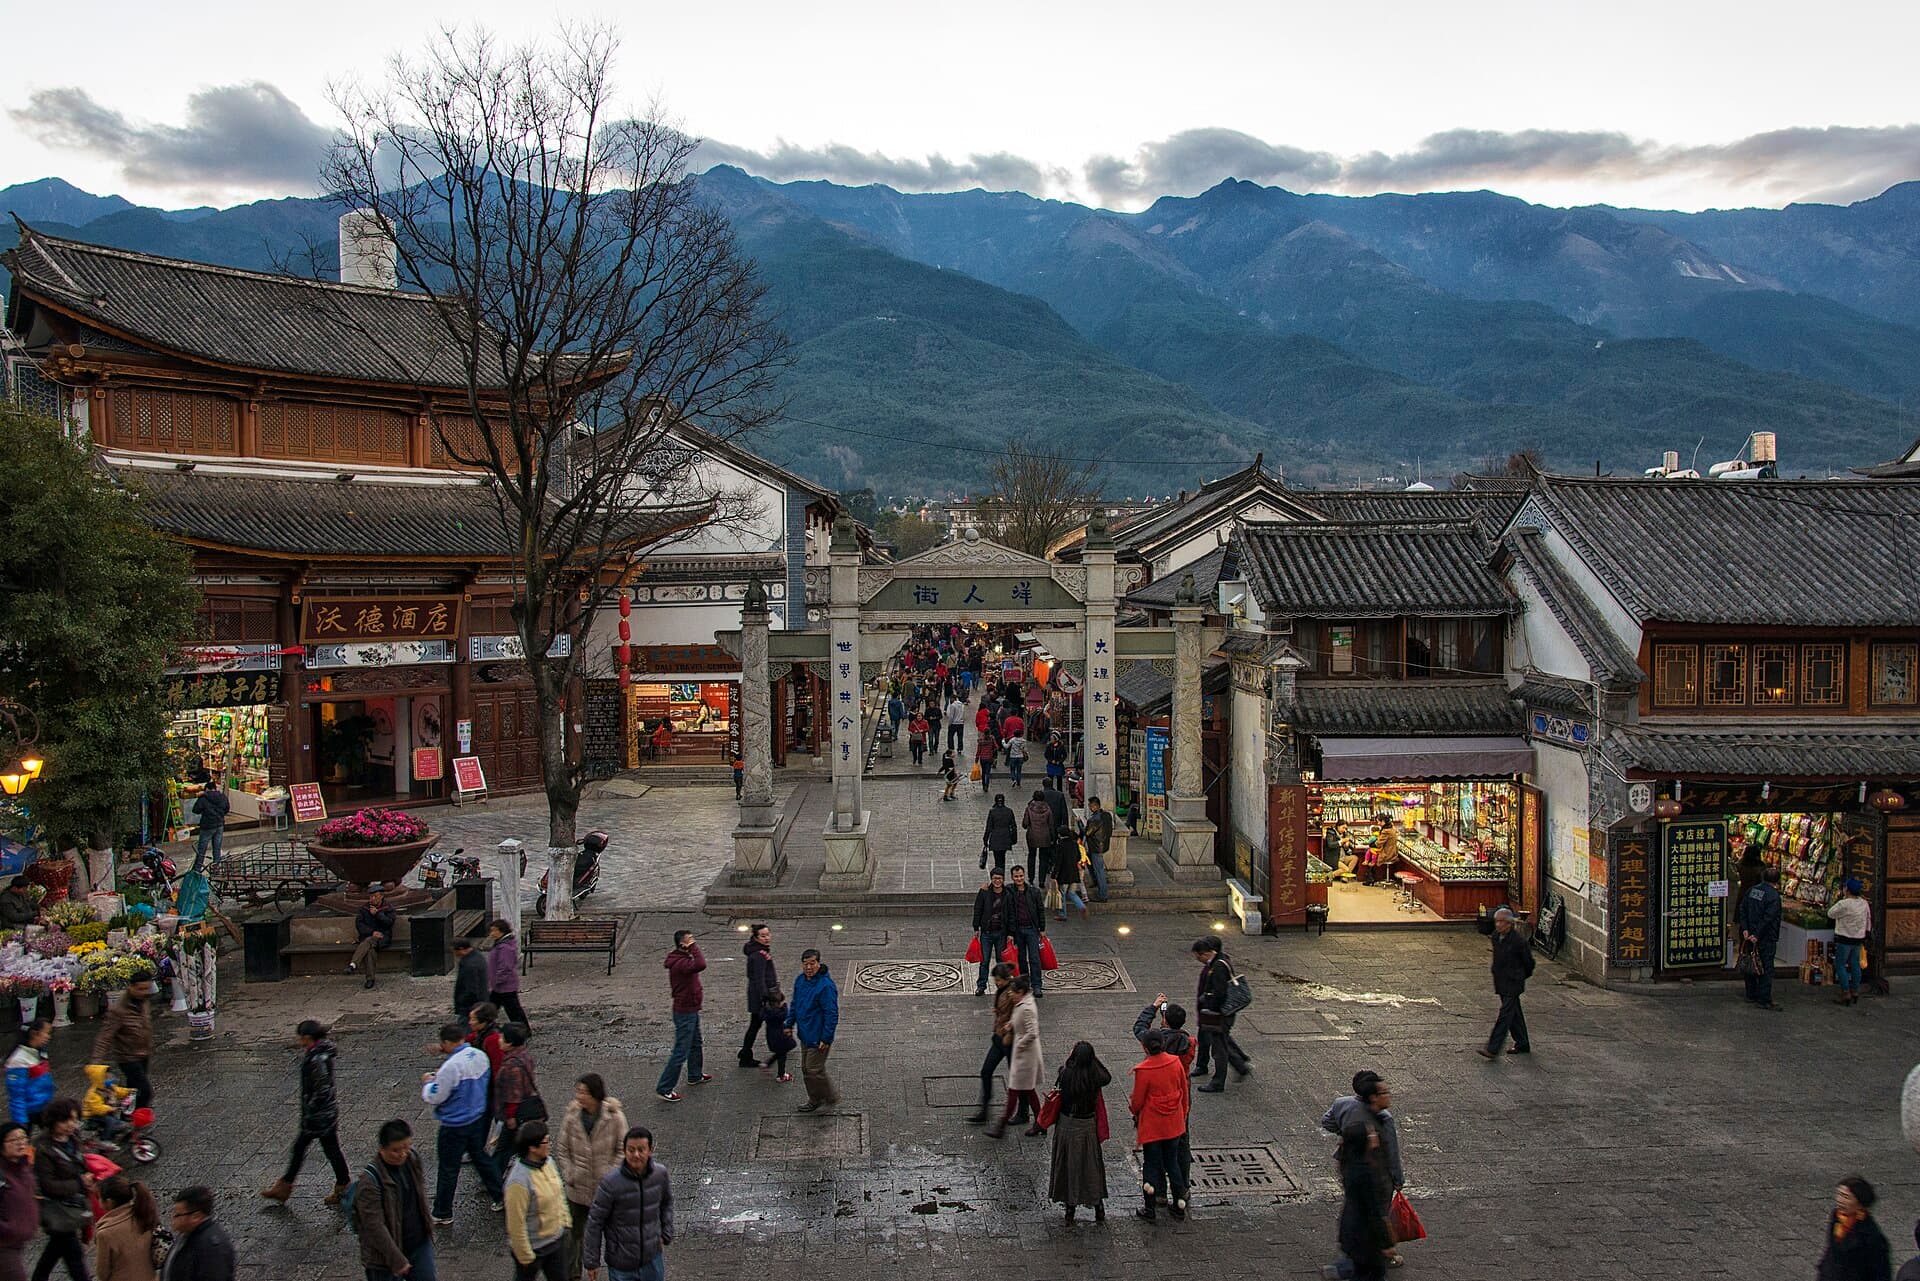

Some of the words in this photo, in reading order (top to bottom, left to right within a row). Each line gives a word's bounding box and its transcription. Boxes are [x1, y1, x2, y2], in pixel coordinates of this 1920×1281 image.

[316, 603, 449, 635] 沃德酒店
[655, 663, 673, 672] DALI
[1277, 789, 1297, 906] 新华传统手工艺
[1675, 828, 1715, 841] 本店经营
[1619, 841, 1647, 959] 大理土特产超市
